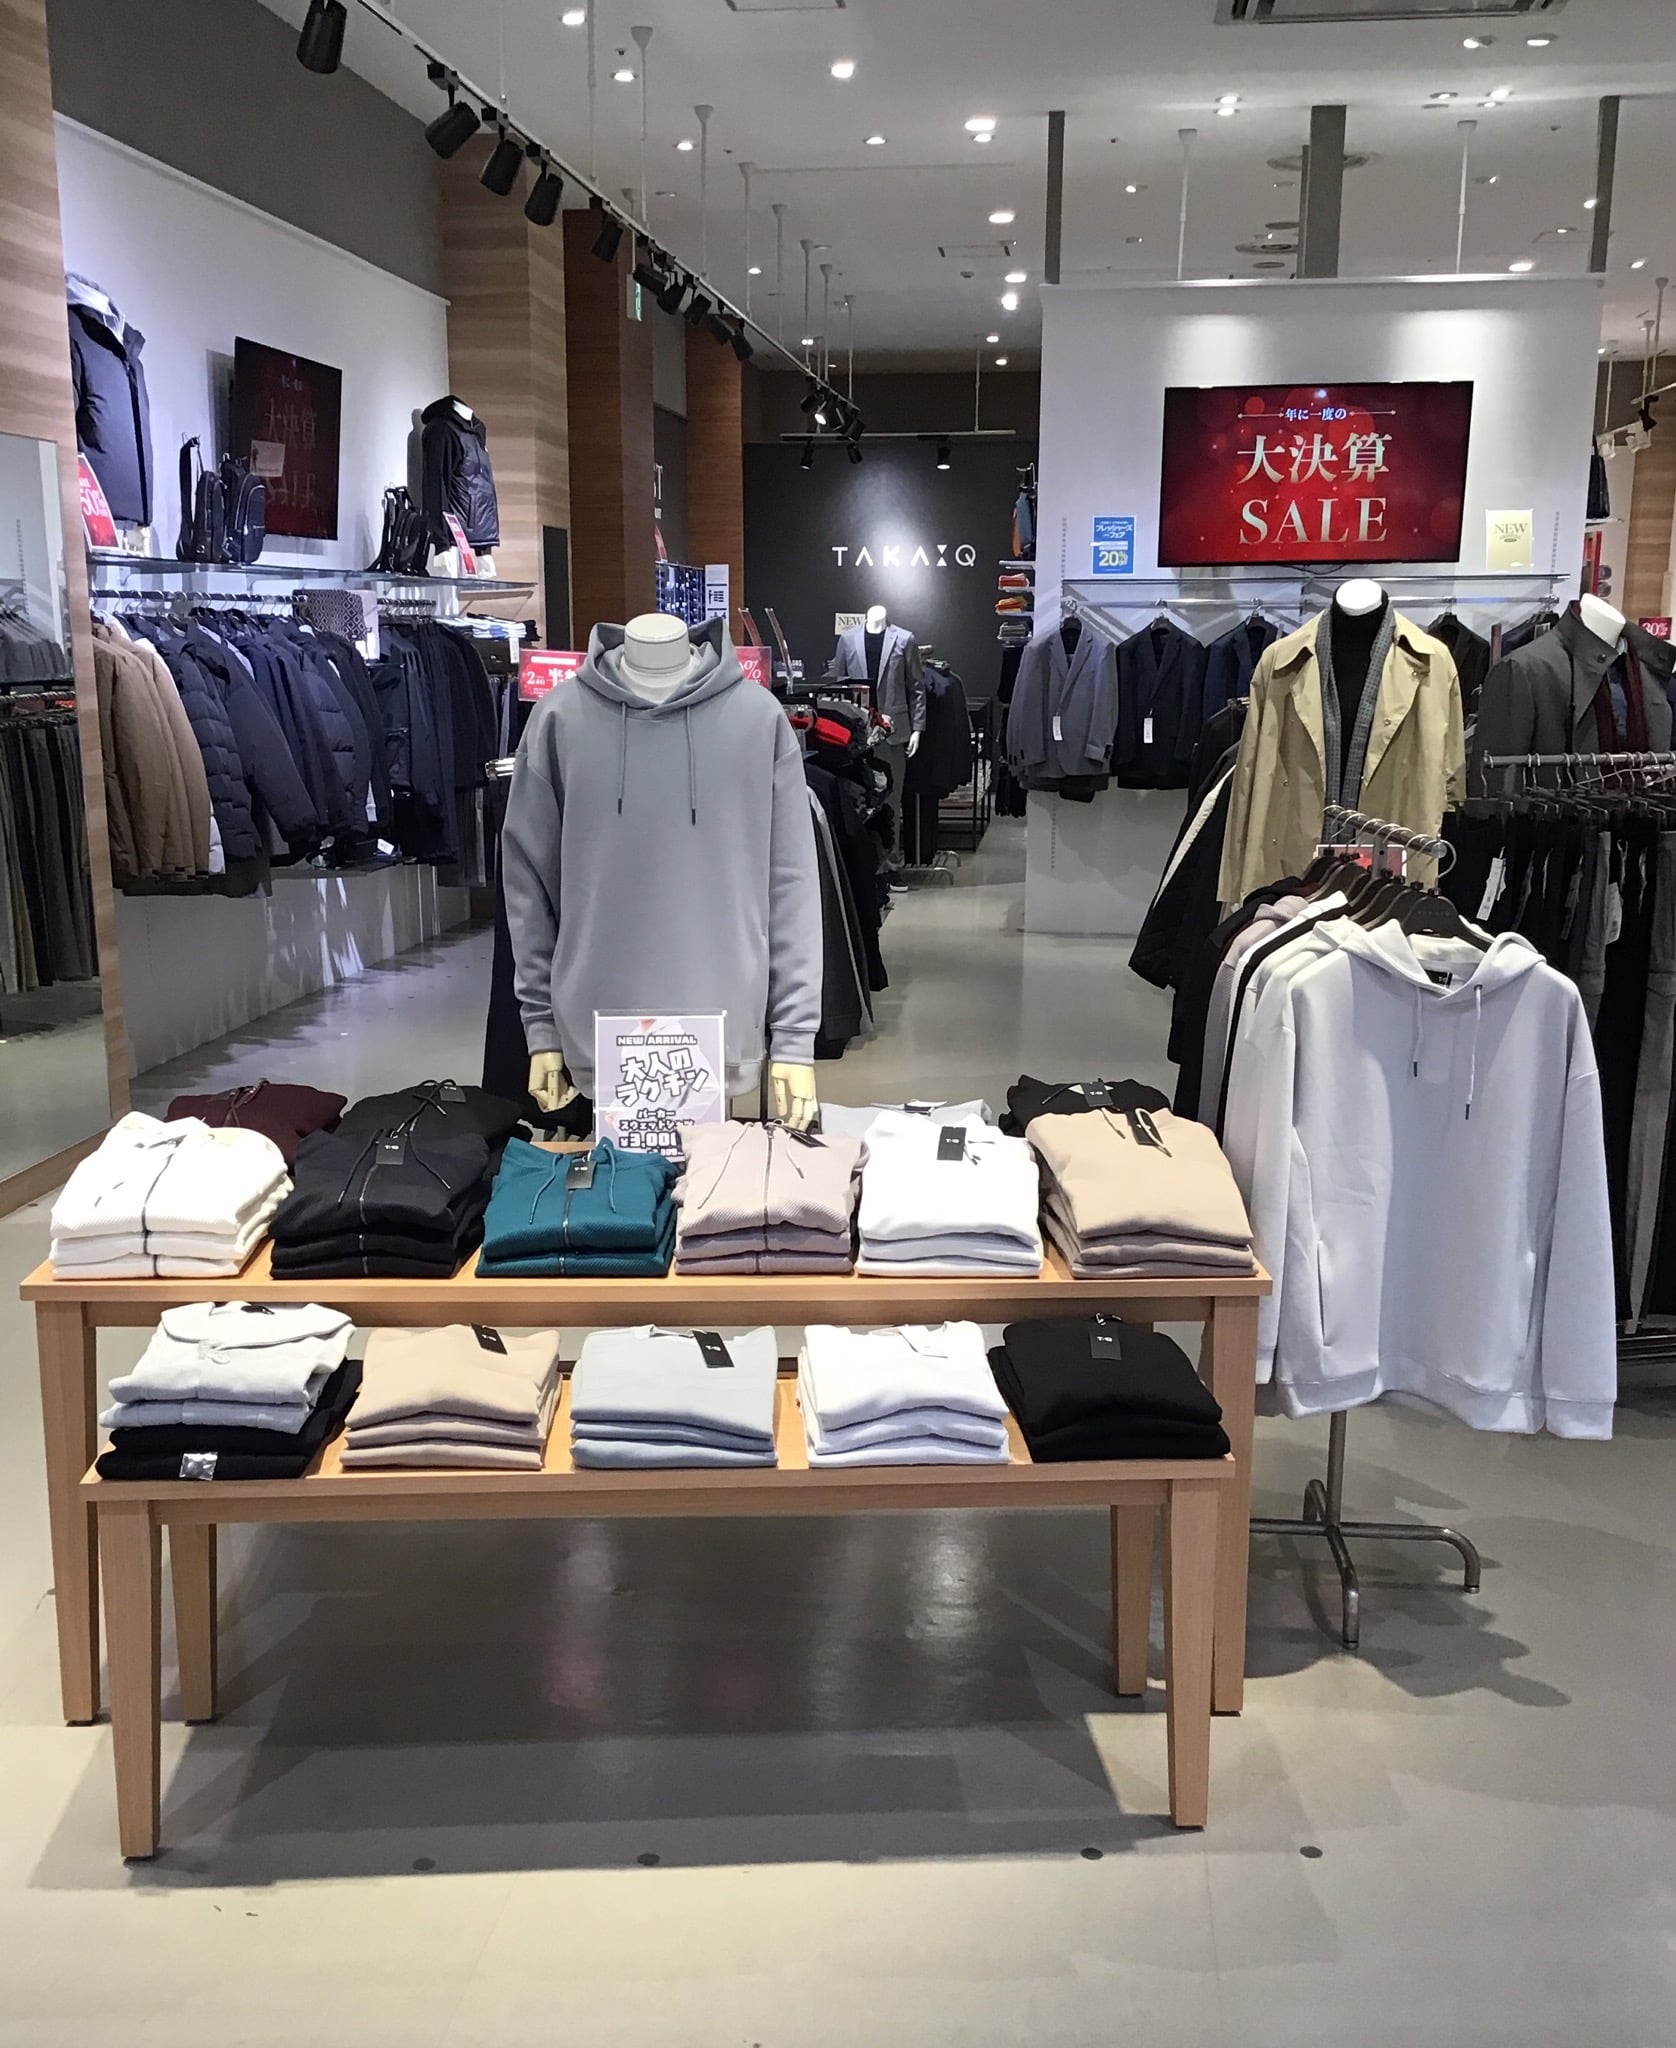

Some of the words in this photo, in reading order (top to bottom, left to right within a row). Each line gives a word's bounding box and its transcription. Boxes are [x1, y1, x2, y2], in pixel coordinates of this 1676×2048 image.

[1285, 408, 1347, 421] 年に一度の
[1237, 432, 1392, 484] 大決算
[1239, 498, 1387, 544] SALE
[1495, 523, 1528, 534] NEW
[617, 1036, 645, 1046] NEW
[646, 1035, 697, 1045] ARRIVAL
[620, 1048, 693, 1083] 大人の
[616, 1068, 709, 1107] ラクチン
[637, 1108, 676, 1119] パーカー
